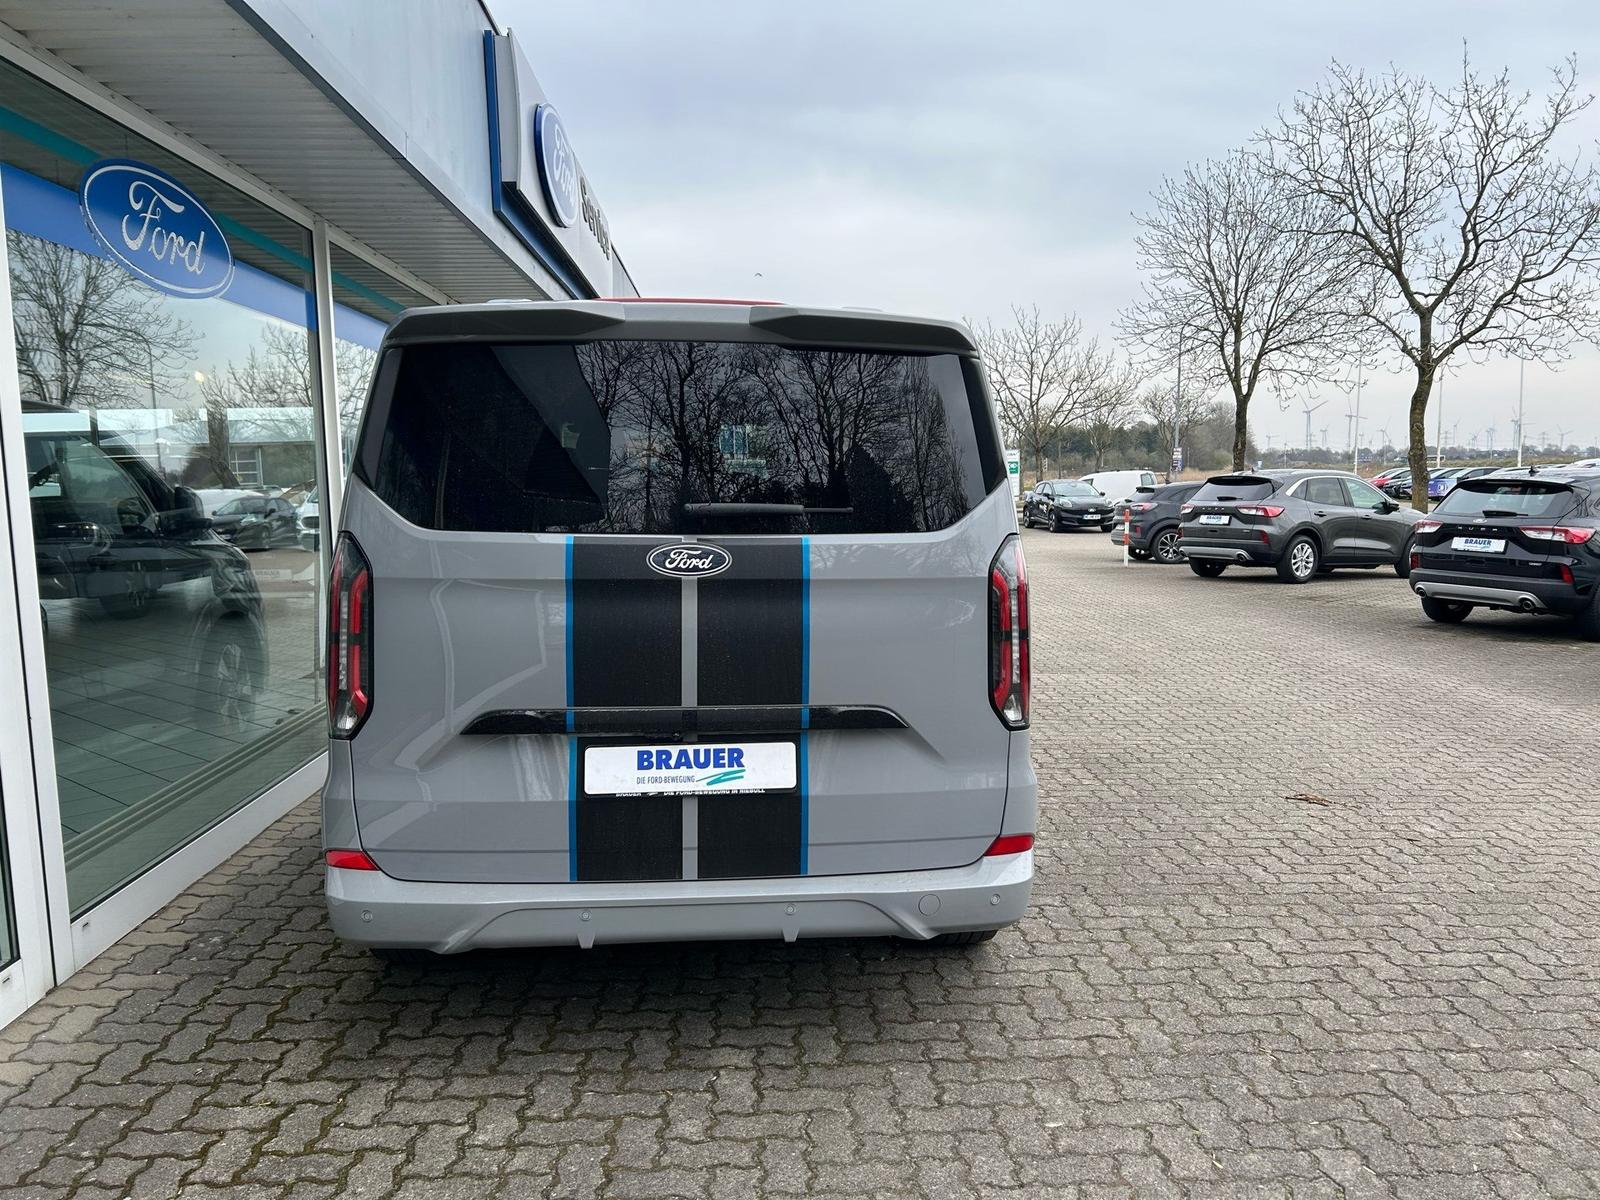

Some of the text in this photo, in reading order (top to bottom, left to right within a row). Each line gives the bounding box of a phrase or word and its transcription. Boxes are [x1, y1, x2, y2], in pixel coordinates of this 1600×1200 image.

[553, 123, 576, 207] Ford
[121, 180, 205, 275] Ford
[1463, 537, 1493, 546] BRAUER
[665, 548, 714, 569] Ford
[636, 747, 746, 771] BRAUER
[636, 774, 696, 785] DIE FORD-BEWEGUNG
